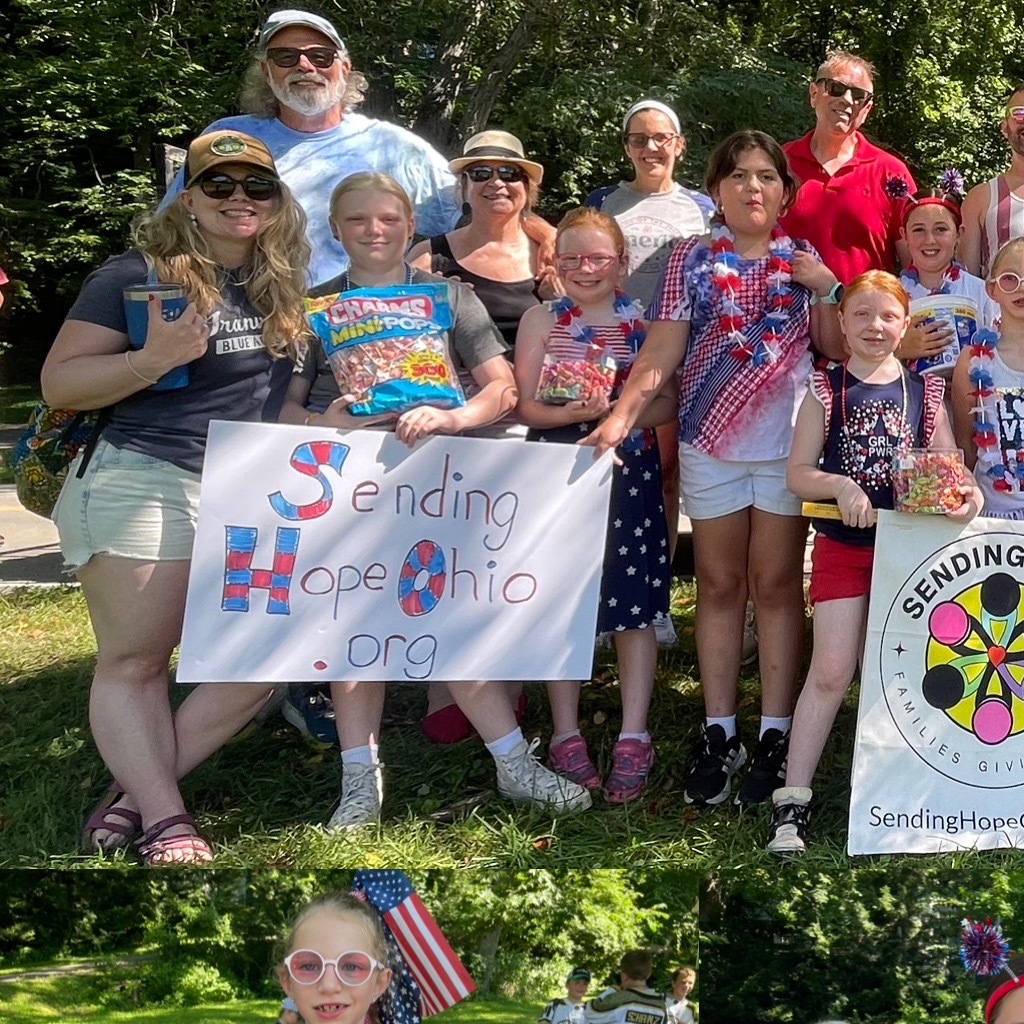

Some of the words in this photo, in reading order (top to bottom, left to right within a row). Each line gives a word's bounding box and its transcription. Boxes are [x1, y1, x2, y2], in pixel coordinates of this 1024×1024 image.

[330, 299, 426, 324] CHARMS
[383, 316, 442, 331] POPS
[222, 338, 250, 352] BLUE
[868, 436, 893, 447] GRL
[868, 447, 893, 457] PWR
[268, 440, 519, 551] Sending
[895, 671, 962, 765] FAMILIES
